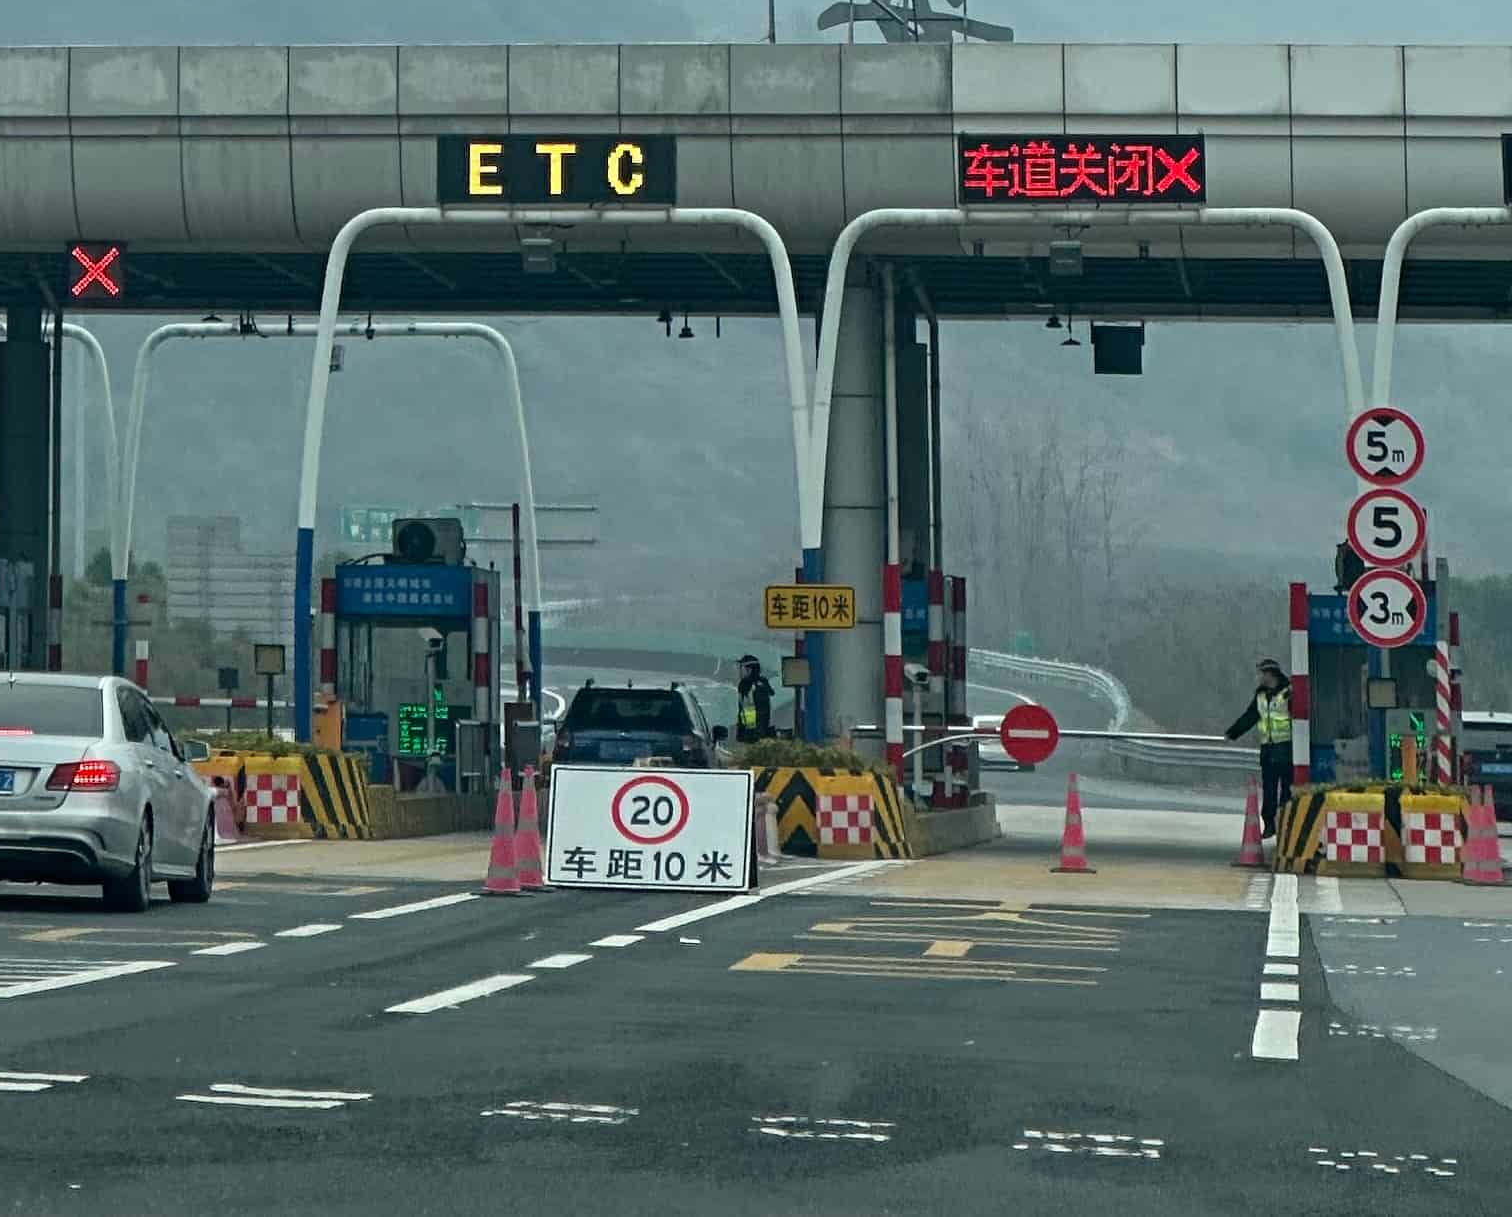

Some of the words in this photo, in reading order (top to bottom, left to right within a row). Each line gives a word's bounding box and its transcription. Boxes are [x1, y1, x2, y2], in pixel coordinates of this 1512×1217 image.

[964, 140, 1153, 197] 车道关闭
[1373, 506, 1402, 548] 5
[770, 593, 849, 621] 车距10米
[631, 796, 674, 825] 20
